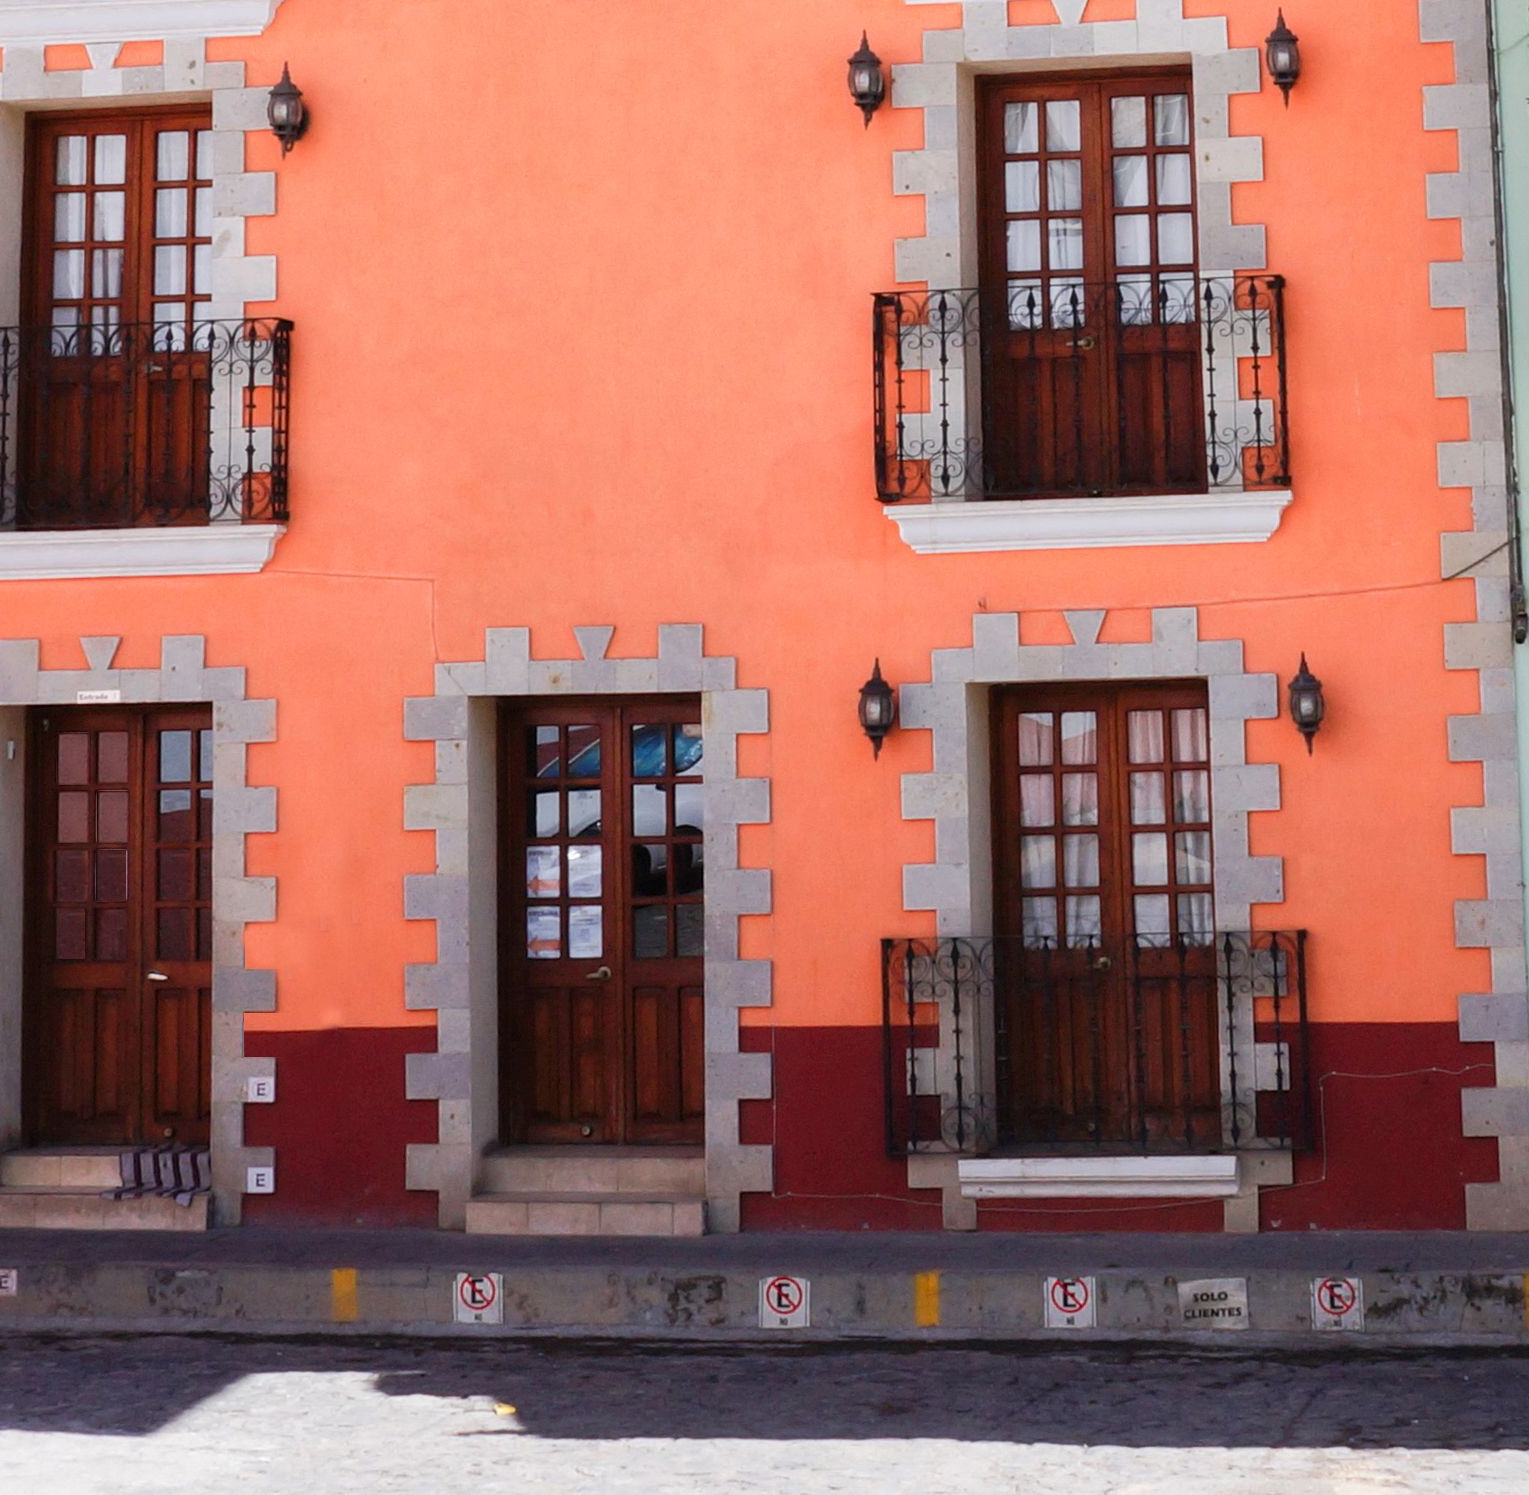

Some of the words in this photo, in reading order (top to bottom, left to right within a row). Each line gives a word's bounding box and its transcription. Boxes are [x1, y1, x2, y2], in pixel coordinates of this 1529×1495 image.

[256, 1082, 266, 1097] E
[255, 1173, 266, 1188] E
[471, 1278, 484, 1304] E
[776, 1283, 791, 1308] E
[1062, 1282, 1077, 1308] E
[1193, 1291, 1228, 1303] SOLO
[1329, 1284, 1344, 1309] E
[1183, 1307, 1242, 1319] CLIENTES
